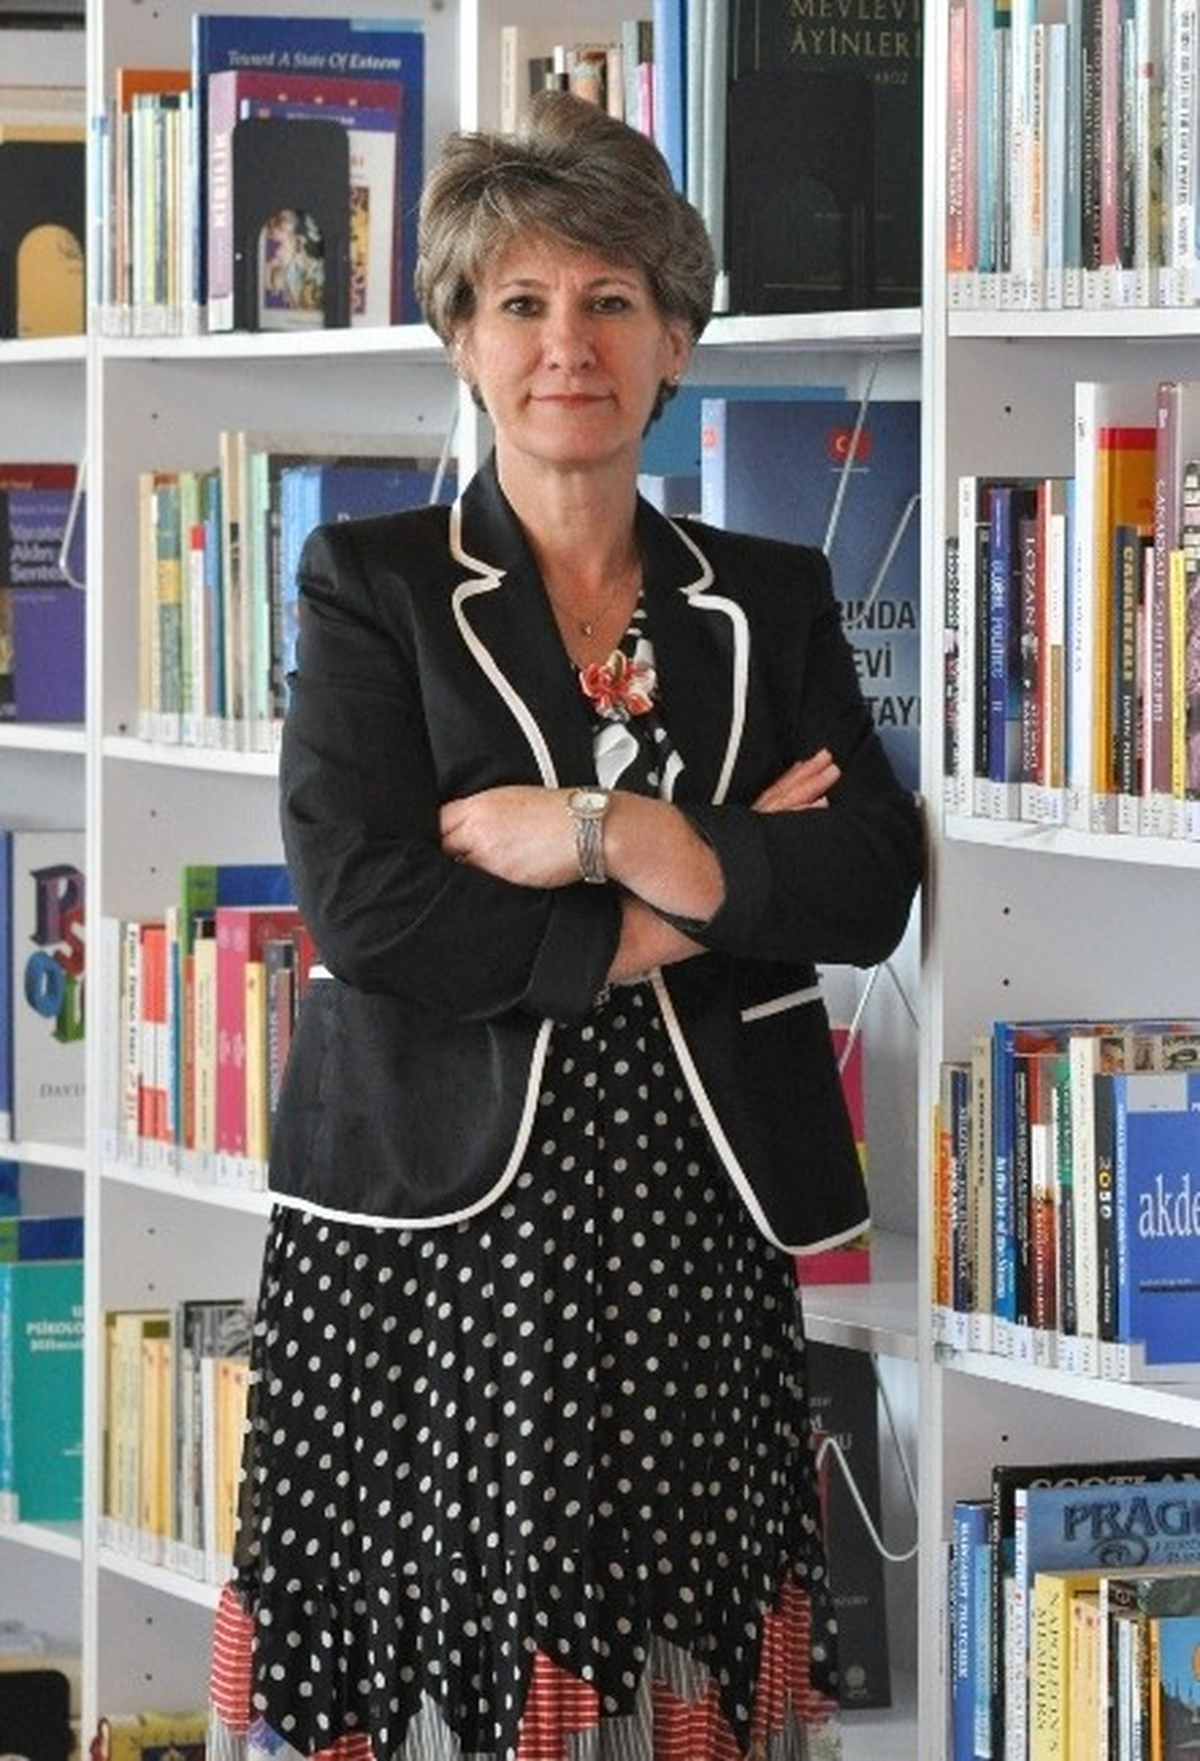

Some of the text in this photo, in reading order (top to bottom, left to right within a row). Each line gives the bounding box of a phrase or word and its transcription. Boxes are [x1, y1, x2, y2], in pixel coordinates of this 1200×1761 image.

[278, 52, 291, 67] A
[328, 53, 349, 71] Of
[839, 601, 916, 629] INDA
